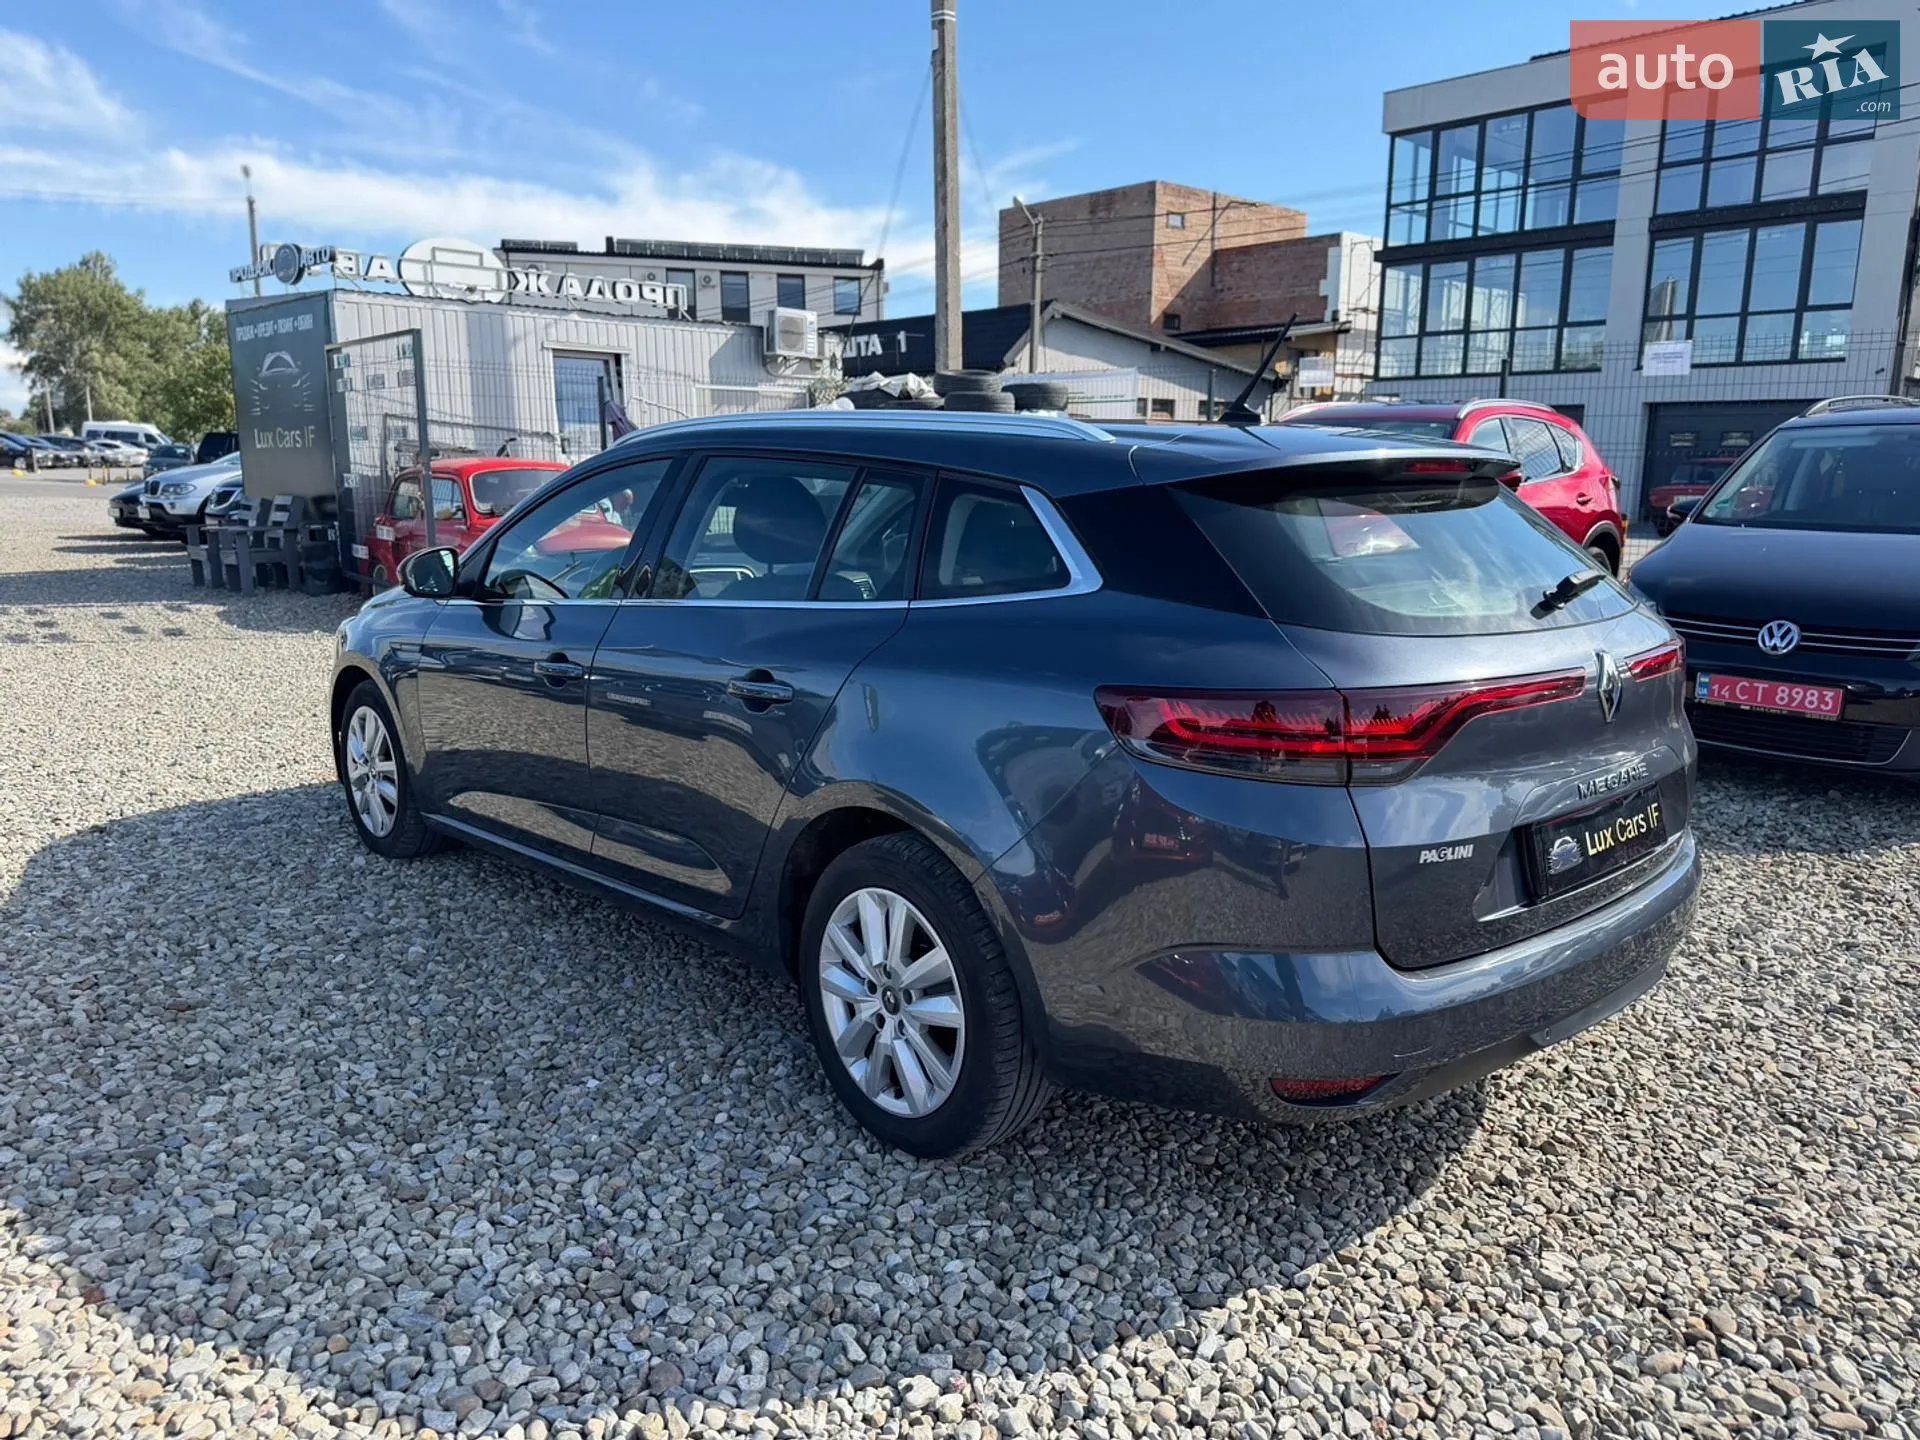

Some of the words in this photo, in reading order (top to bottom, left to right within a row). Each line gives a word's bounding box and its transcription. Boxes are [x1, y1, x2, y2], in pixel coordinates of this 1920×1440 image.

[300, 247, 330, 268] АВТО
[254, 428, 274, 449] Lux
[276, 426, 303, 449] Cars
[303, 424, 315, 449] IF
[1711, 684, 1731, 699] 14
[1775, 686, 1835, 711] 8983
[1585, 827, 1615, 856] Lux
[1615, 813, 1647, 842] Cars
[1647, 802, 1660, 831] IF
[1419, 844, 1474, 864] PAGLINI
